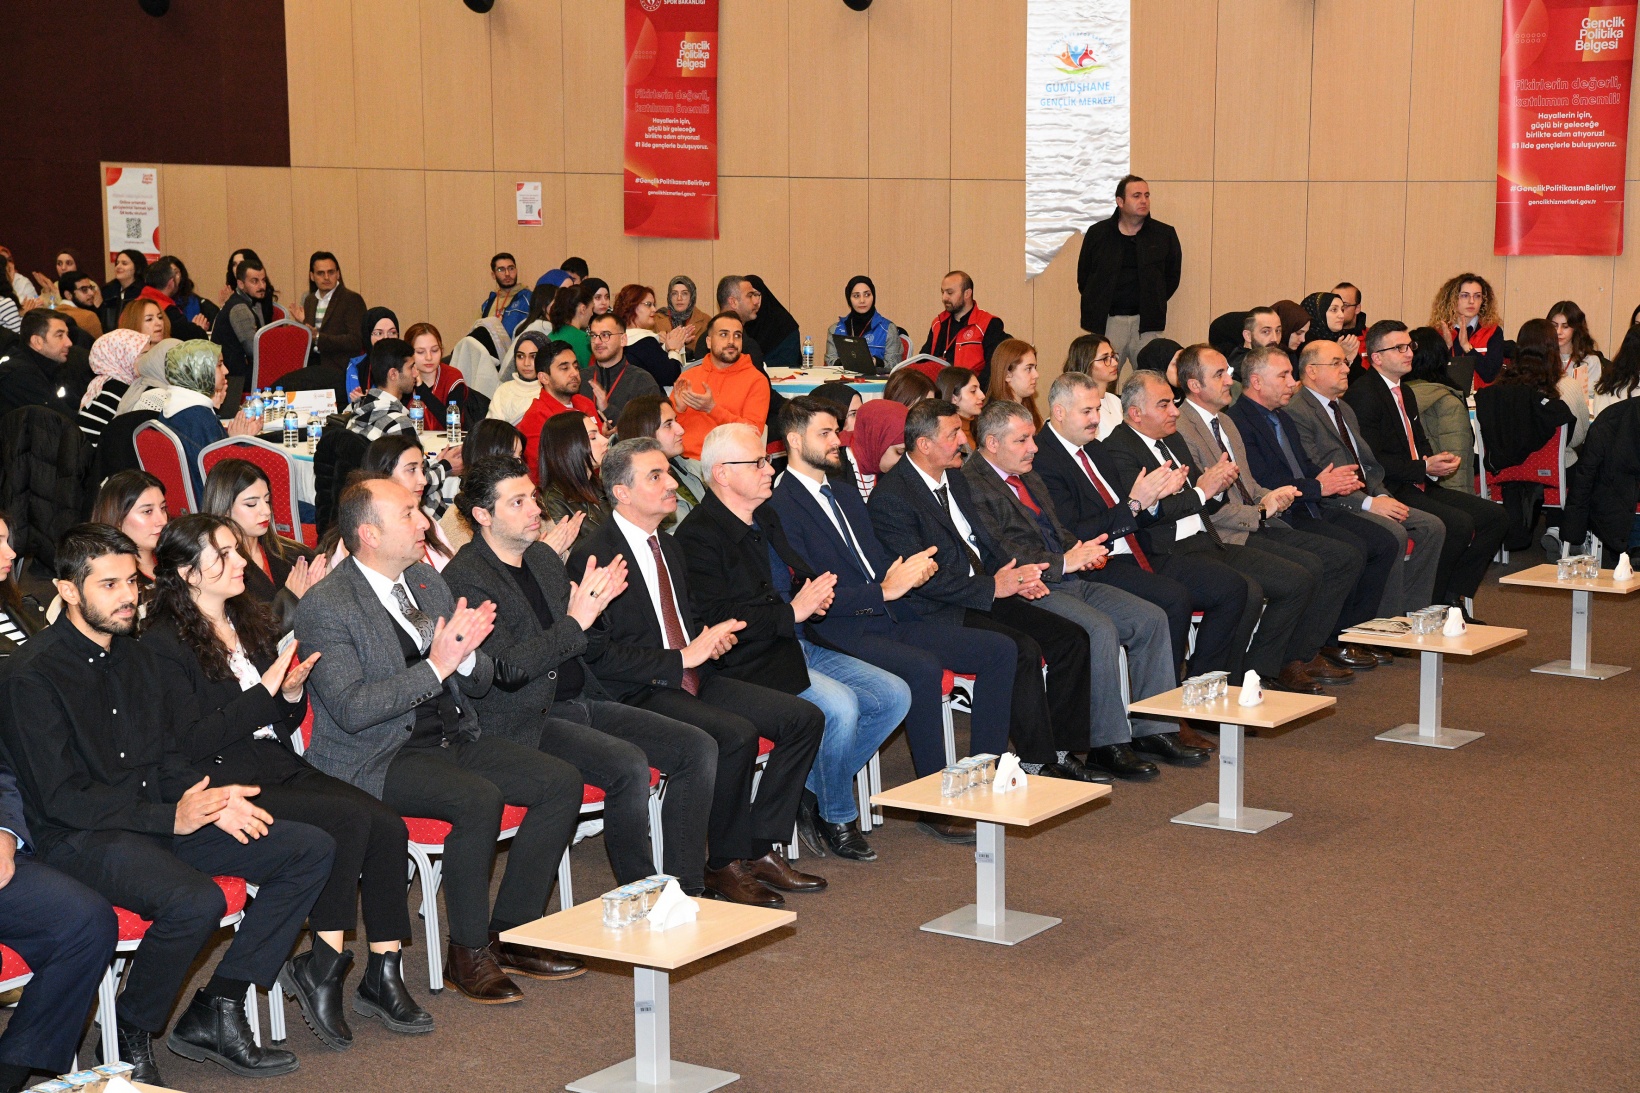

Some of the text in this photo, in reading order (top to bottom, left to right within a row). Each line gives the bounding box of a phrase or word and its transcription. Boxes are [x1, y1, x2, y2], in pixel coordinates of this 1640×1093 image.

[1580, 28, 1624, 40] Politika
[1575, 38, 1618, 53] Belgesi
[679, 49, 709, 59] Politika
[676, 58, 706, 70] Belgesi
[1514, 76, 1621, 91] Fikirlerin değerli,
[635, 89, 673, 99] Fikirlerin
[1514, 93, 1621, 107] katılımın önemli!
[1538, 111, 1592, 120] Hayallerin için,
[1531, 122, 1551, 130] güçlü
[1564, 121, 1599, 130] geleceğe
[677, 143, 708, 151] buluşuyoruz.
[1536, 142, 1570, 150] gençlerle
[1572, 141, 1616, 149] buluşuyoruz.
[1511, 184, 1616, 193] #GençlikPolitikasınıBelirliyor
